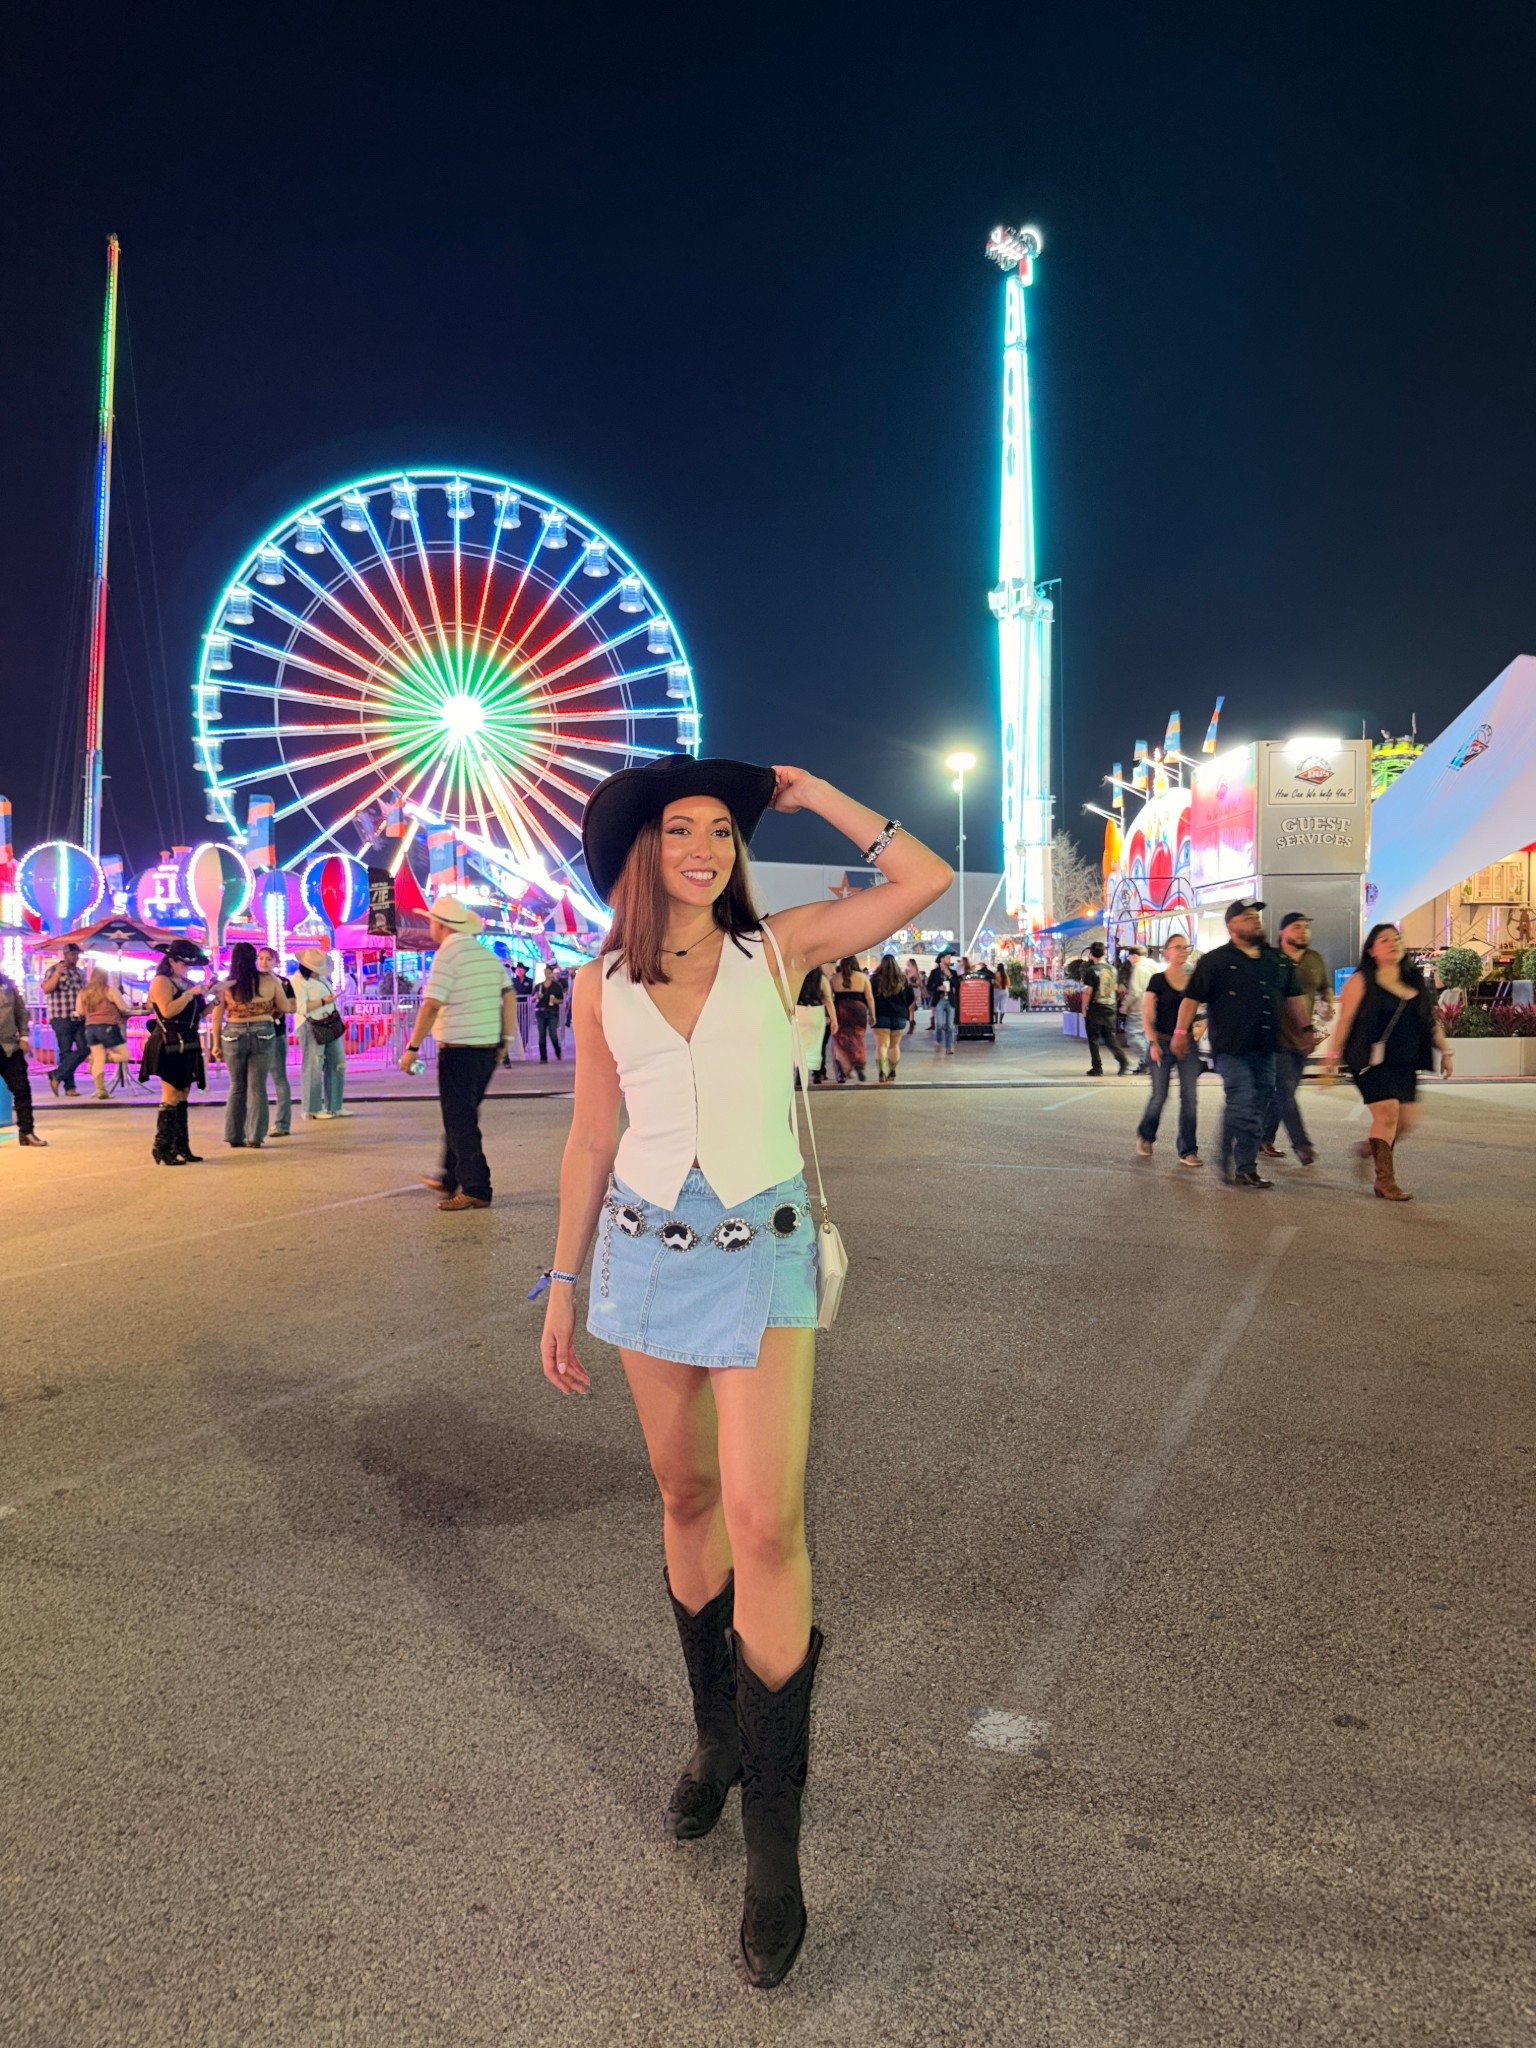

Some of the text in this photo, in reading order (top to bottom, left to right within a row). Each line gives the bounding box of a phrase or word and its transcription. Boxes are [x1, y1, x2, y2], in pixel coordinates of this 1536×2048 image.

[1275, 789, 1289, 798] How
[1292, 788, 1304, 798] Can
[1307, 788, 1316, 798] We
[1336, 788, 1353, 798] You?
[1281, 816, 1351, 833] GUEST
[1276, 833, 1353, 849] SERVICES
[355, 1003, 380, 1014] EXIT
